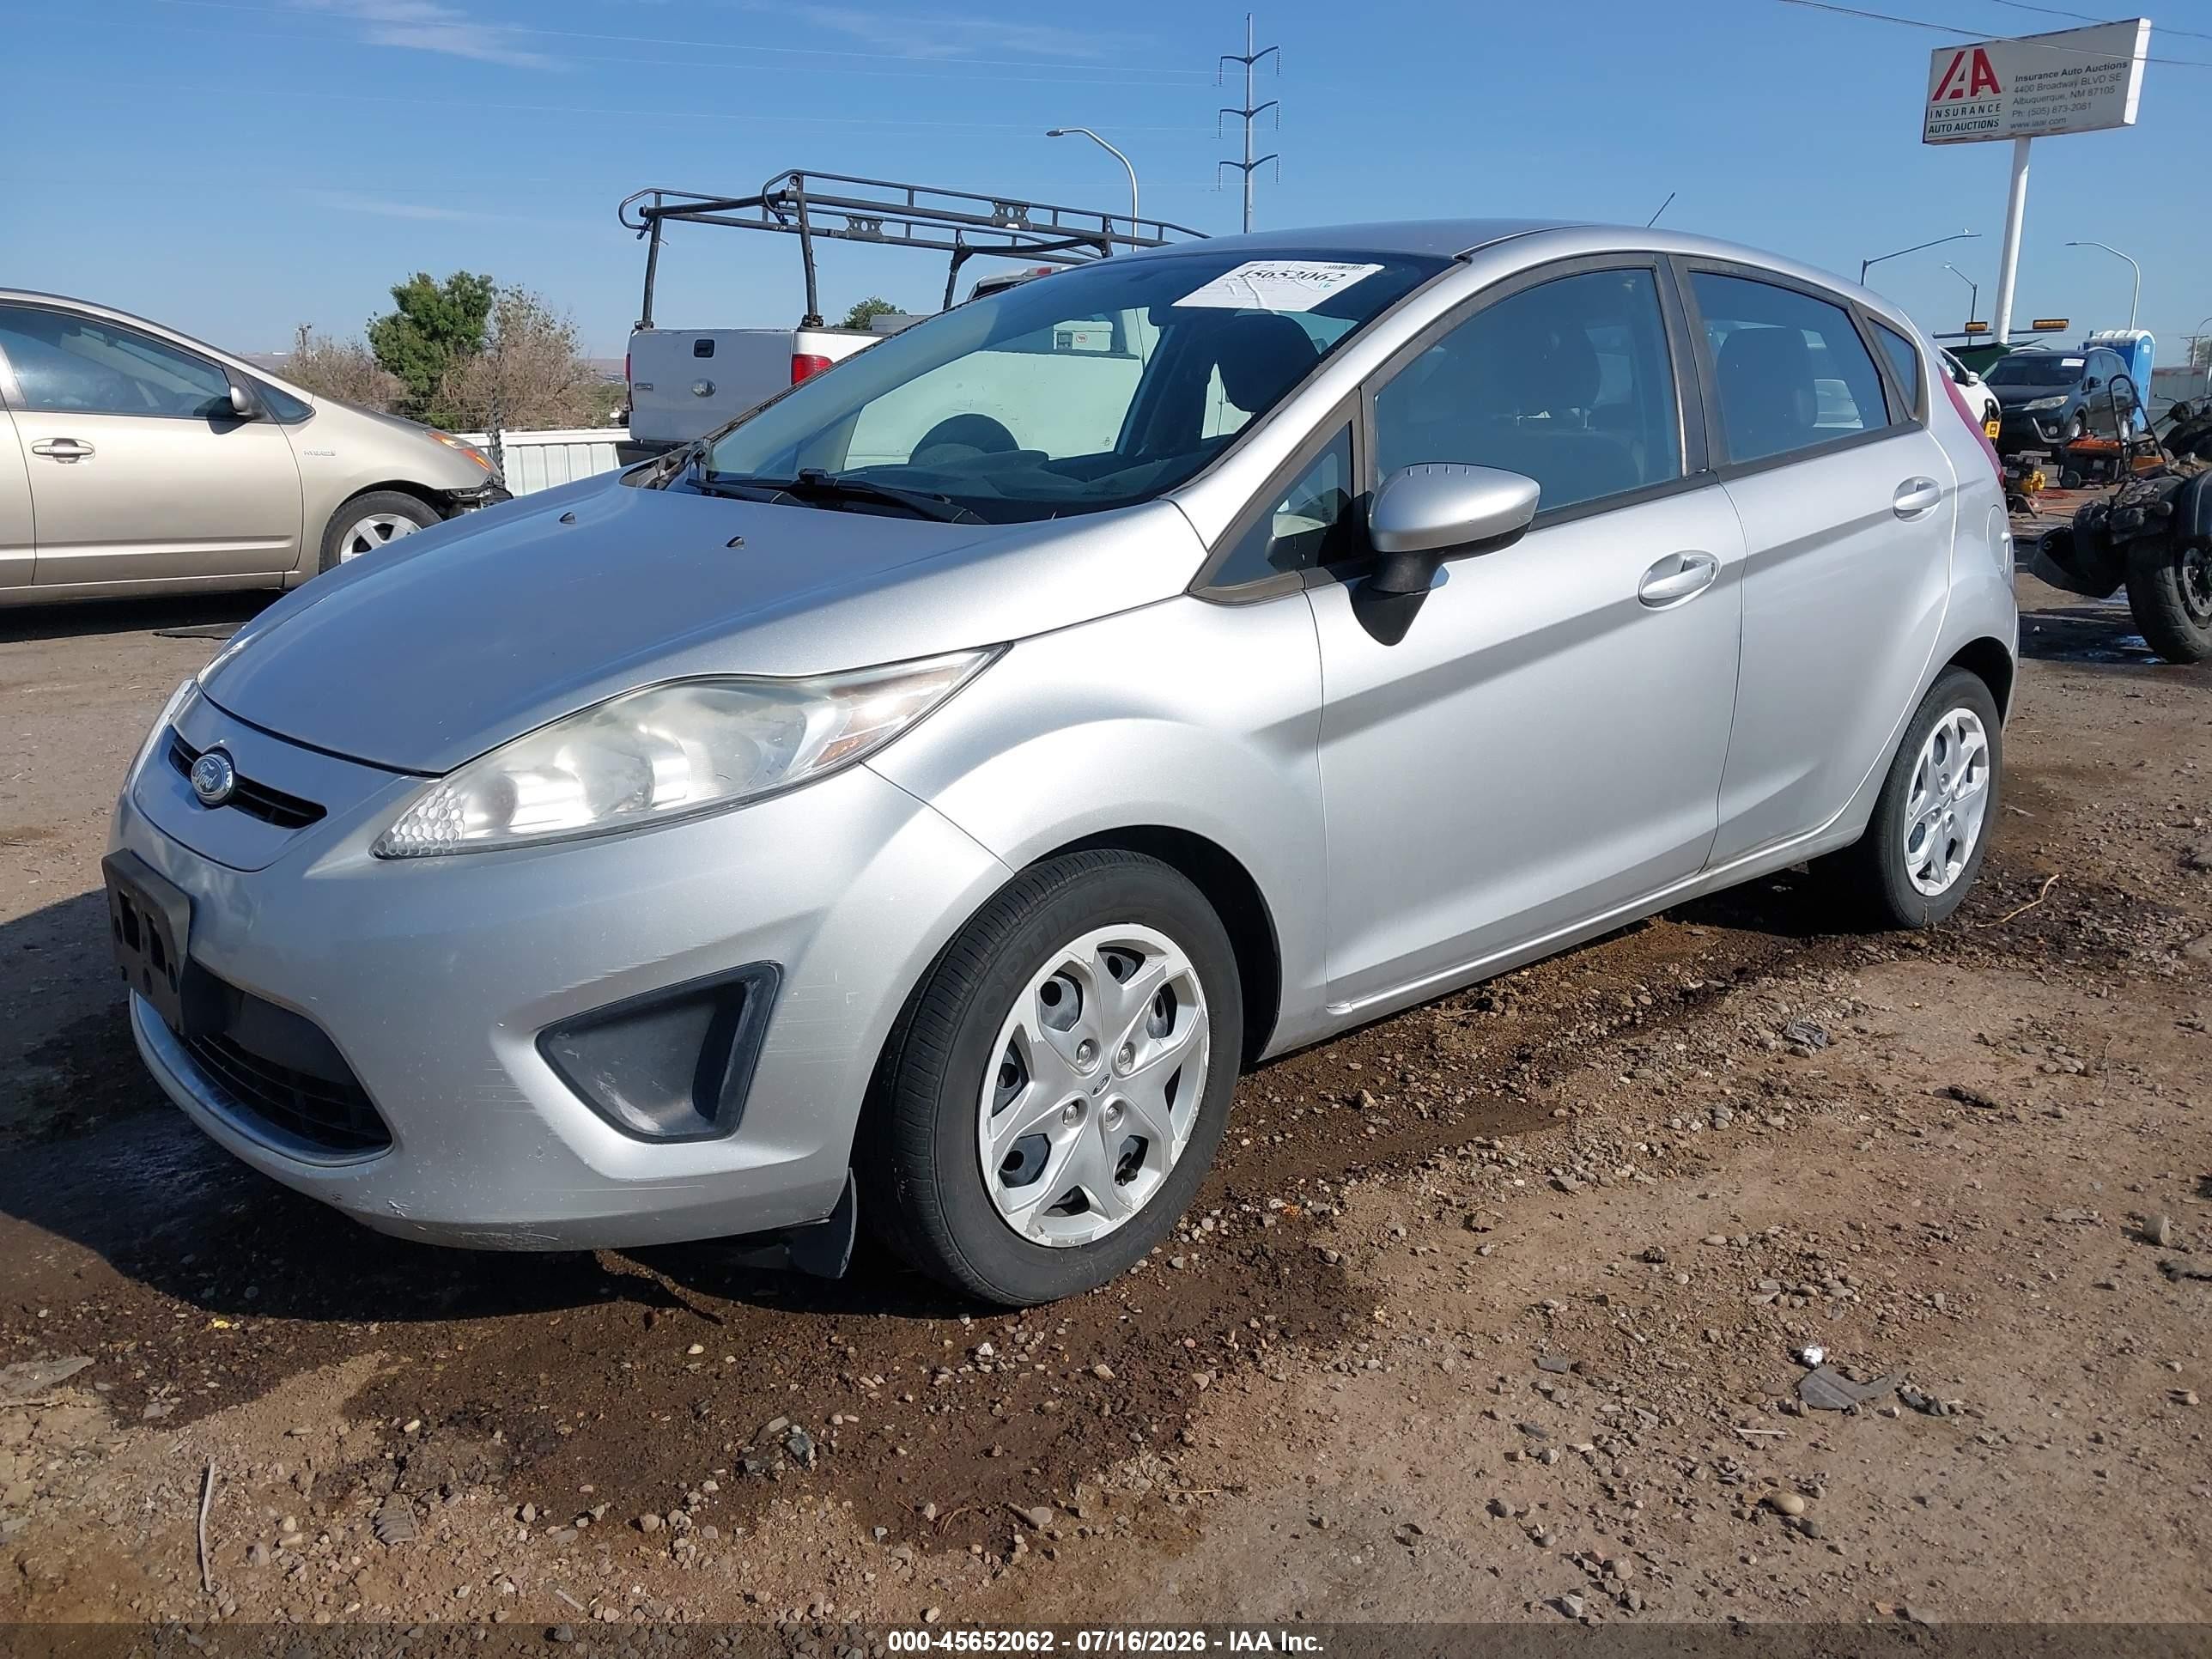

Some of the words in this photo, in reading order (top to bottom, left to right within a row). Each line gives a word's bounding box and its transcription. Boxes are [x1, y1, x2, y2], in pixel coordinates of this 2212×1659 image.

[2015, 72, 2059, 82] Insurance
[2061, 68, 2083, 76] Auto
[2085, 62, 2128, 74] Auctions
[2014, 84, 2035, 94] 4400
[2037, 80, 2078, 91] Broadway
[2081, 75, 2106, 86] BLVD
[2108, 72, 2123, 82] SE
[2069, 90, 2086, 99] NM
[2087, 85, 2116, 97] 87105
[1930, 103, 2002, 118] INSURANCE
[2027, 106, 2051, 118] (505)
[1928, 123, 1953, 134] AUTO
[1954, 118, 2000, 131] AUCTIONS
[196, 761, 218, 790] Ford
